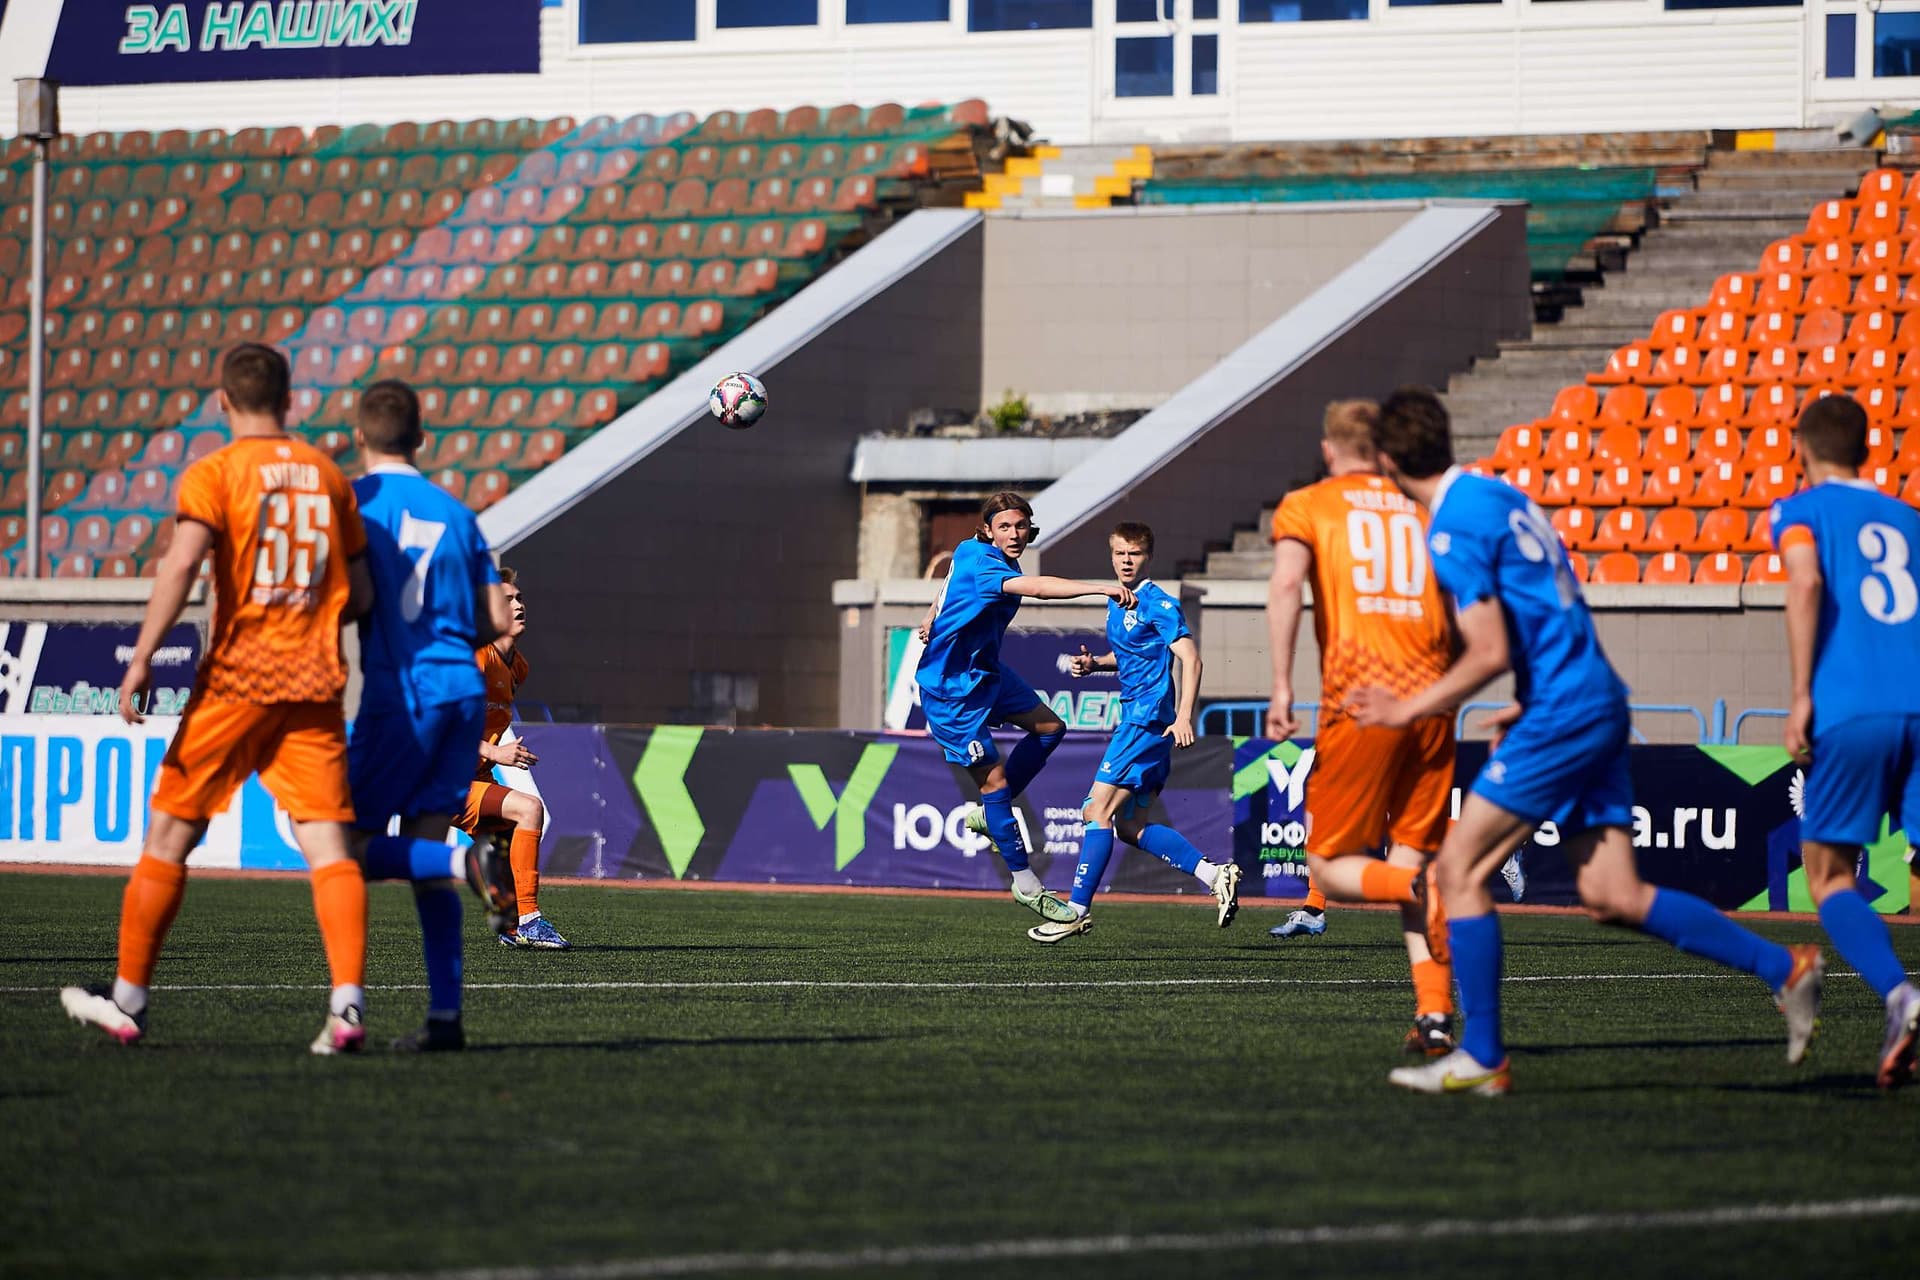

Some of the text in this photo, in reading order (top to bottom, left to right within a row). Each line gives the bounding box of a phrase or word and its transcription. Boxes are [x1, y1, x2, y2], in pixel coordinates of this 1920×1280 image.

[119, 0, 419, 55] ЗА НАШИХ!
[254, 492, 330, 587] 65
[400, 508, 447, 624] 7
[1346, 509, 1427, 597] 90
[1857, 521, 1919, 625] 3
[31, 680, 151, 715] БЬЁМ
[0, 735, 190, 842] ПРО
